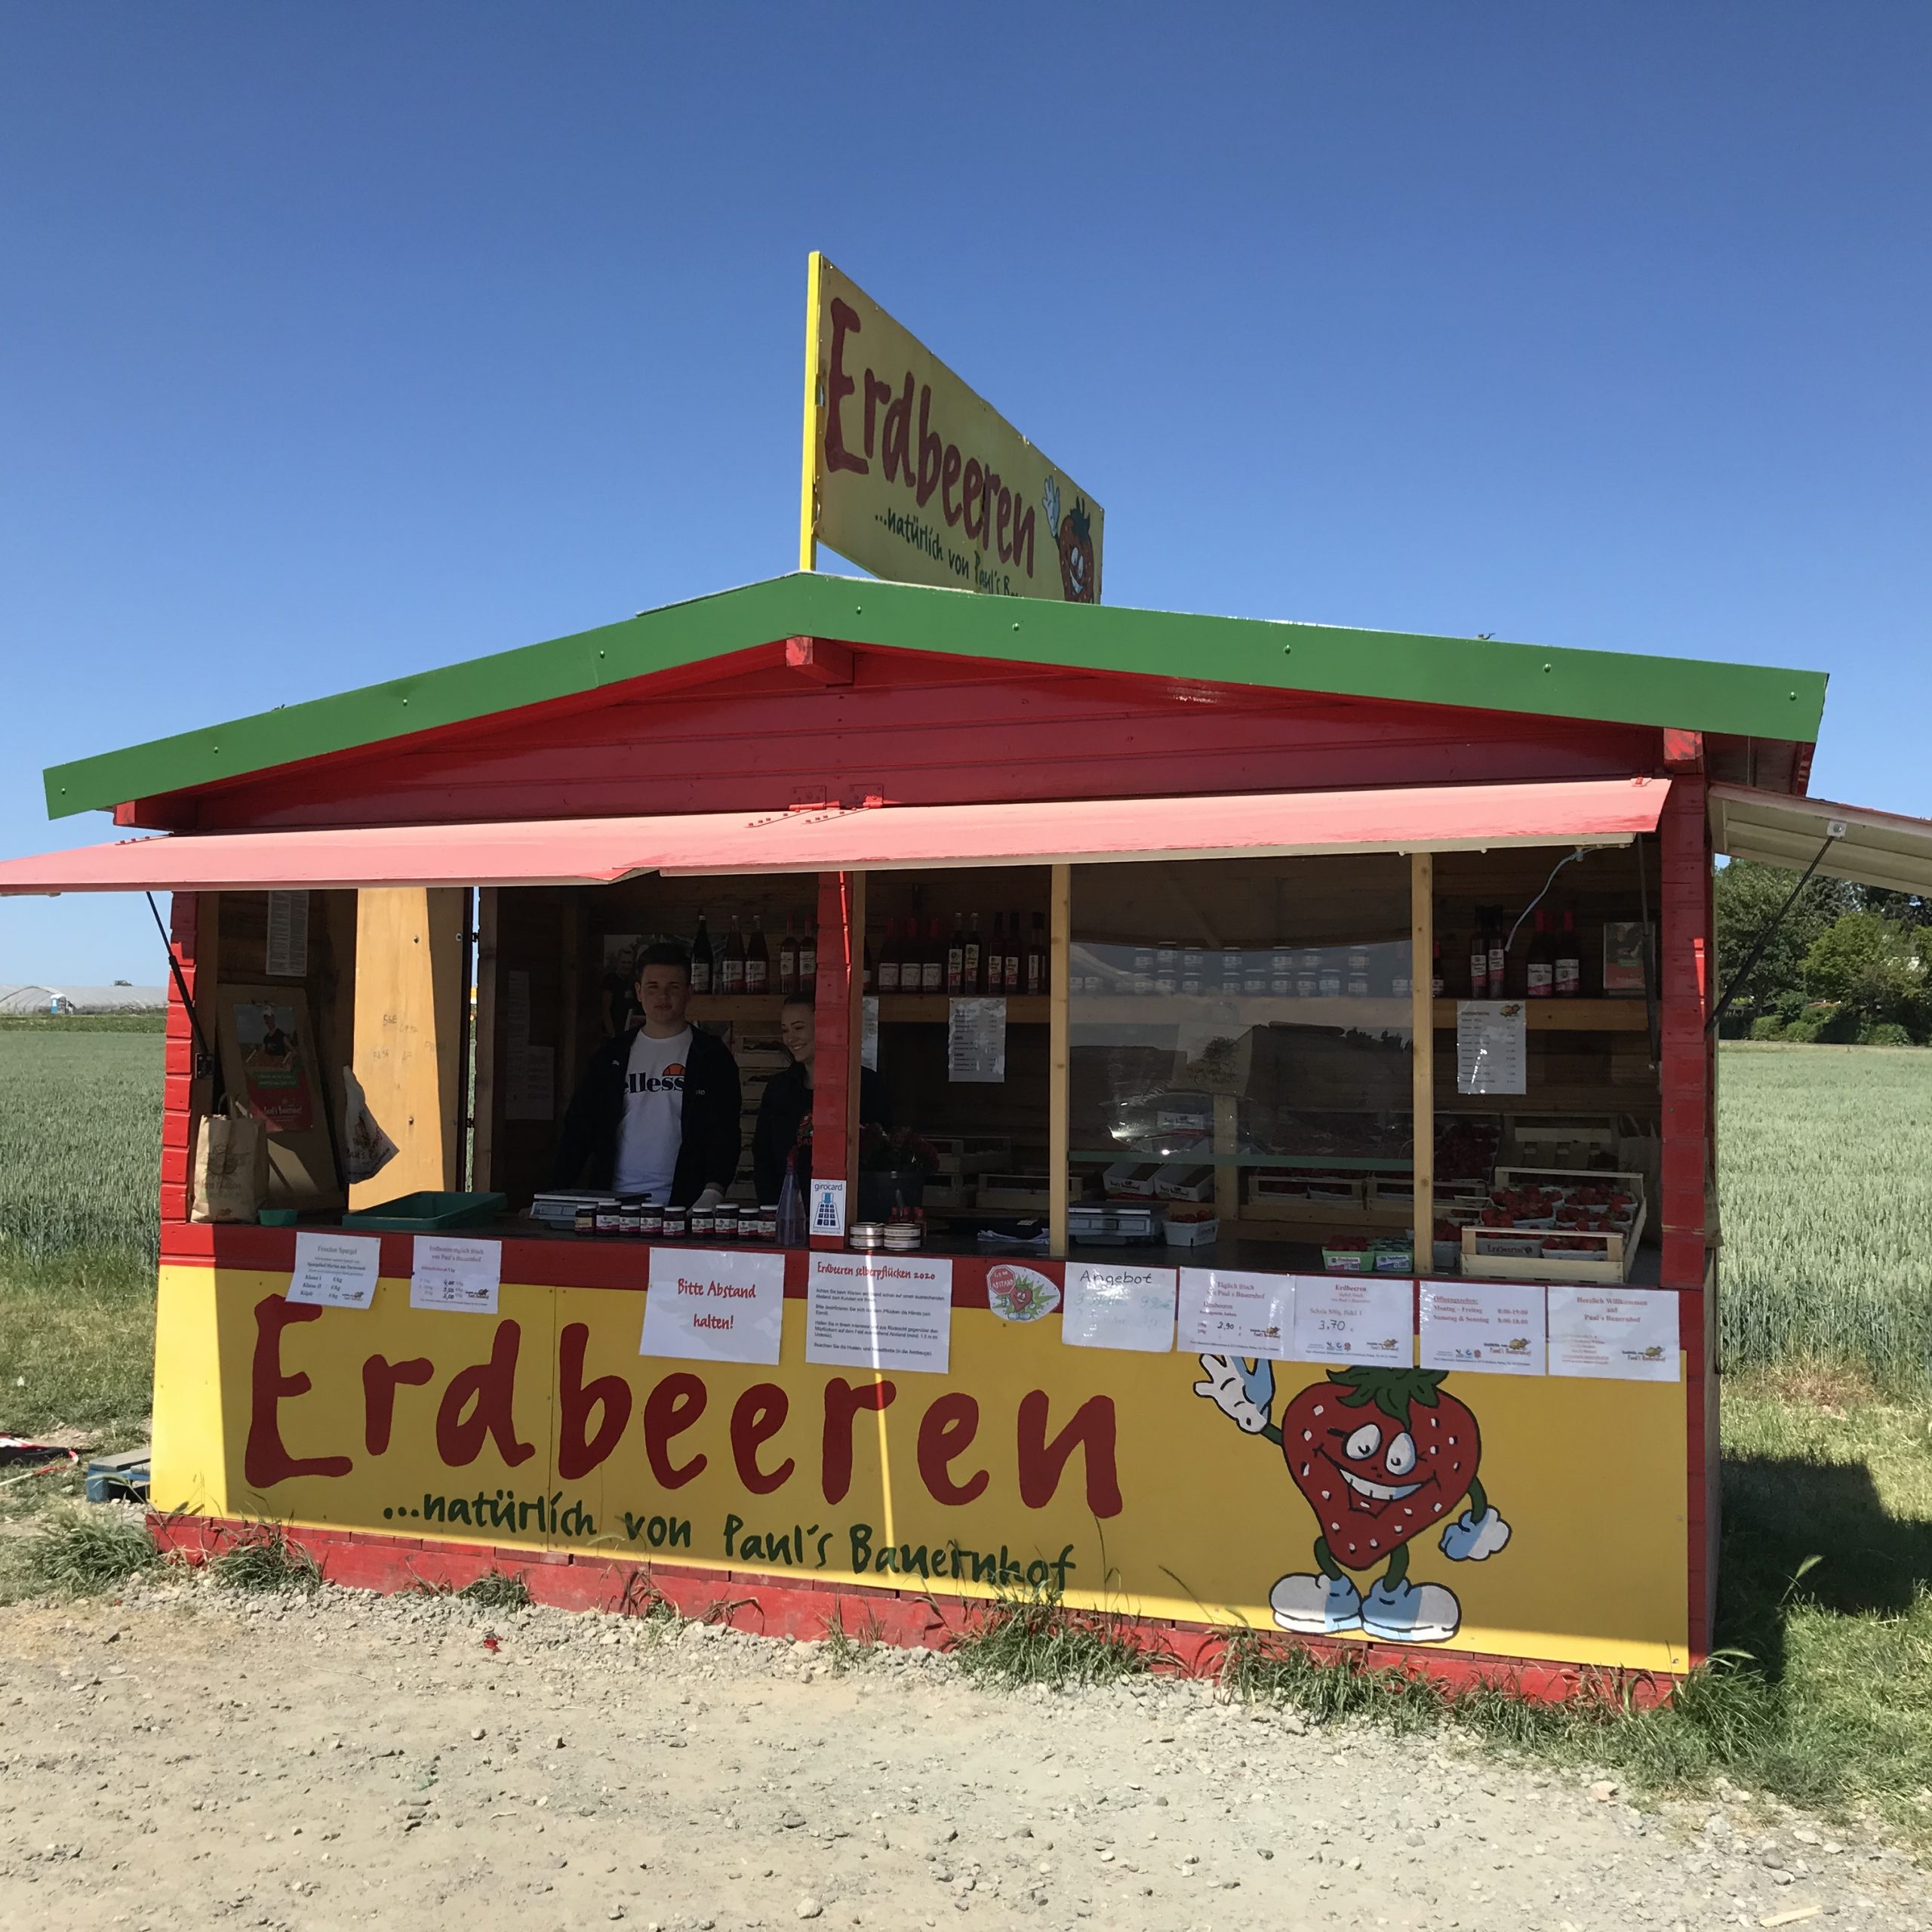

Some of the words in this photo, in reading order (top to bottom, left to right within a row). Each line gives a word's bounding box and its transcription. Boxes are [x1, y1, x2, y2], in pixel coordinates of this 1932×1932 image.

[824, 297, 1035, 579] Erdbeeren
[875, 507, 943, 561] ...natürlich
[949, 549, 969, 580] von
[814, 1183, 843, 1192] girocard
[817, 1261, 854, 1275] Erdbeeren
[856, 1265, 912, 1281] selberpflücken
[914, 1272, 936, 1280] 2020
[1080, 1270, 1152, 1285] Angebot
[678, 1278, 705, 1296] Bitte
[707, 1281, 757, 1299] Abstand
[1335, 1284, 1367, 1292] Erdbeeren
[1577, 1297, 1604, 1305] Herzlich
[1606, 1297, 1648, 1306] Willkommen
[1462, 1306, 1483, 1315] Freitag
[693, 1313, 734, 1330] halten!
[1217, 1321, 1235, 1331] 2,90
[1434, 1315, 1457, 1323] Samstag
[1606, 1315, 1641, 1323] Bauernhof
[245, 1293, 1124, 1518] Erdbeeren
[383, 1489, 598, 1537] ...natürlich
[623, 1512, 692, 1549] von
[723, 1513, 835, 1570] Paul's
[849, 1523, 1076, 1594] Bauernhof
